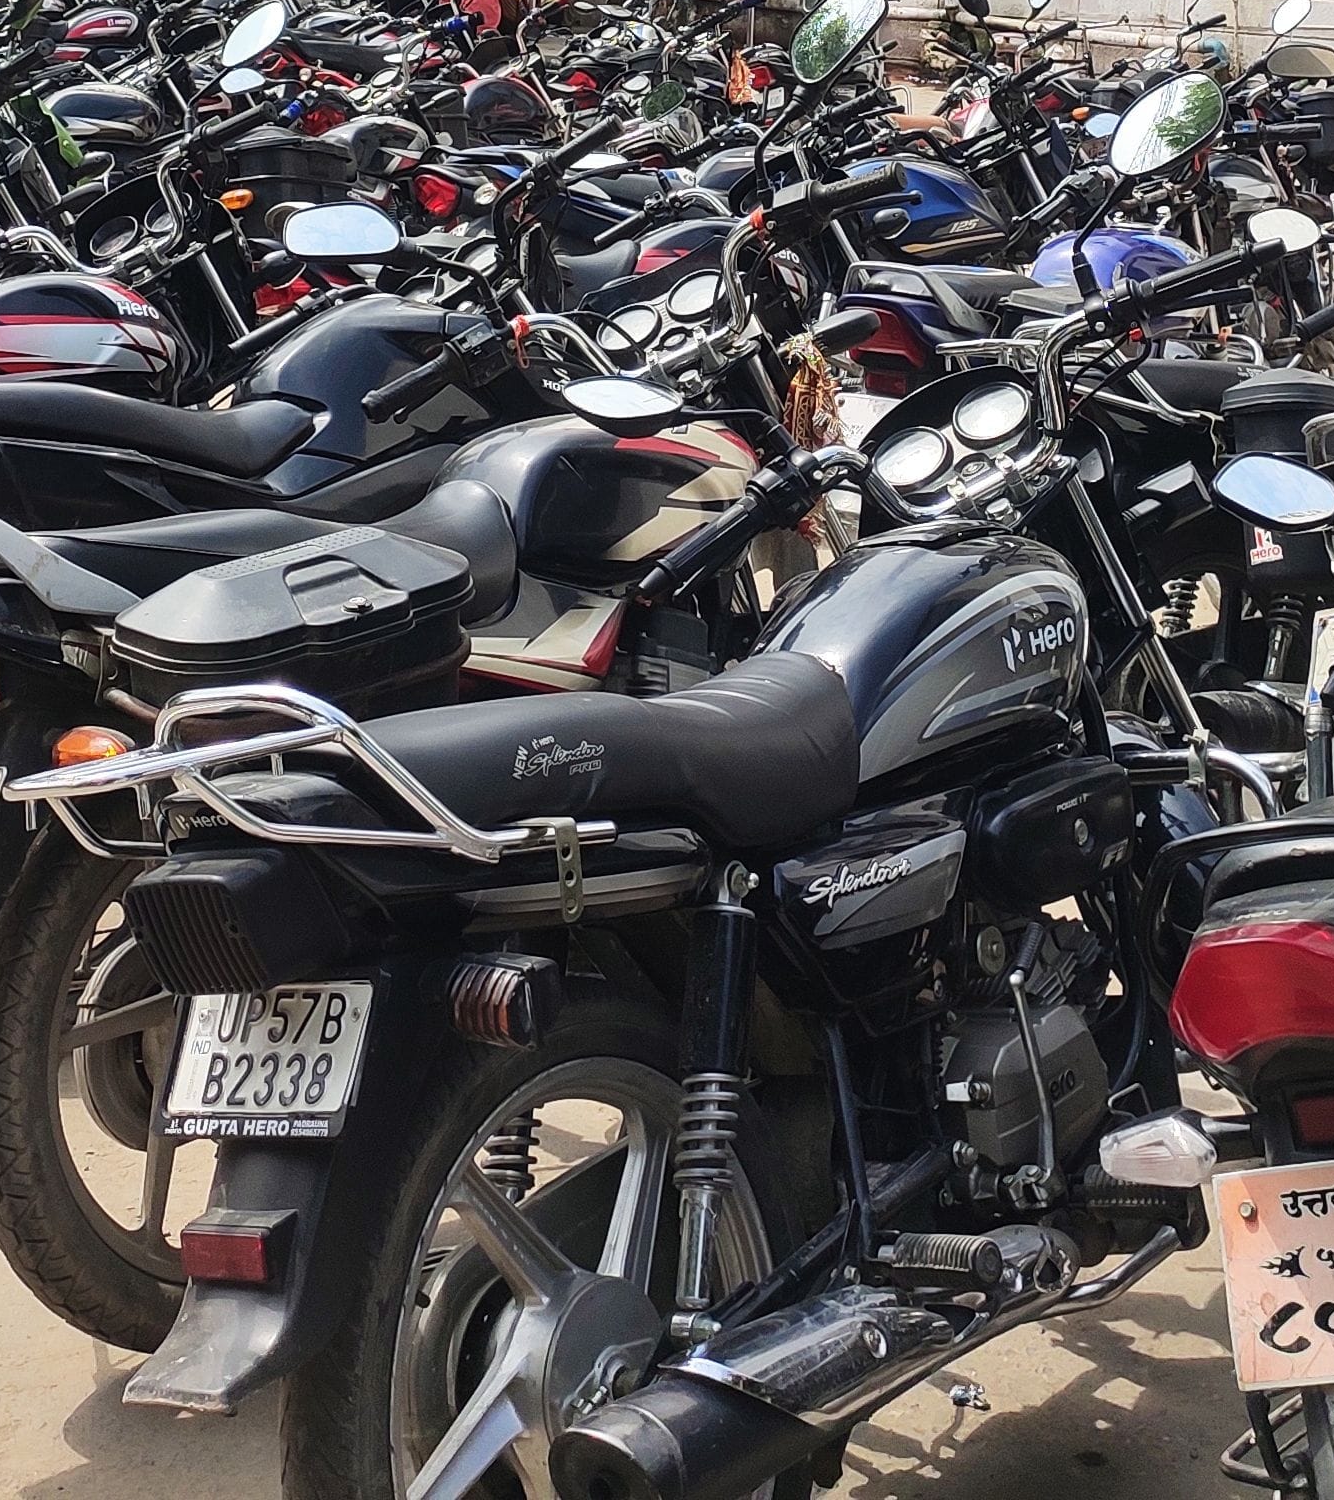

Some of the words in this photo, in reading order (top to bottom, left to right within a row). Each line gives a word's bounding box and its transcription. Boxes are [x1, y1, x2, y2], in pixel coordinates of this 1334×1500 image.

[949, 218, 980, 234] 125
[116, 301, 160, 319] Hero
[1251, 546, 1281, 561] Hero
[1028, 617, 1075, 656] Hero
[512, 745, 529, 780] NEW
[524, 740, 605, 778] Splendor
[217, 992, 348, 1045] UP57B
[190, 1040, 212, 1055] IND
[201, 1052, 334, 1107] B2338
[1049, 1067, 1076, 1103] ero
[183, 1118, 239, 1137] GUPTA
[242, 1119, 290, 1137] HERO
